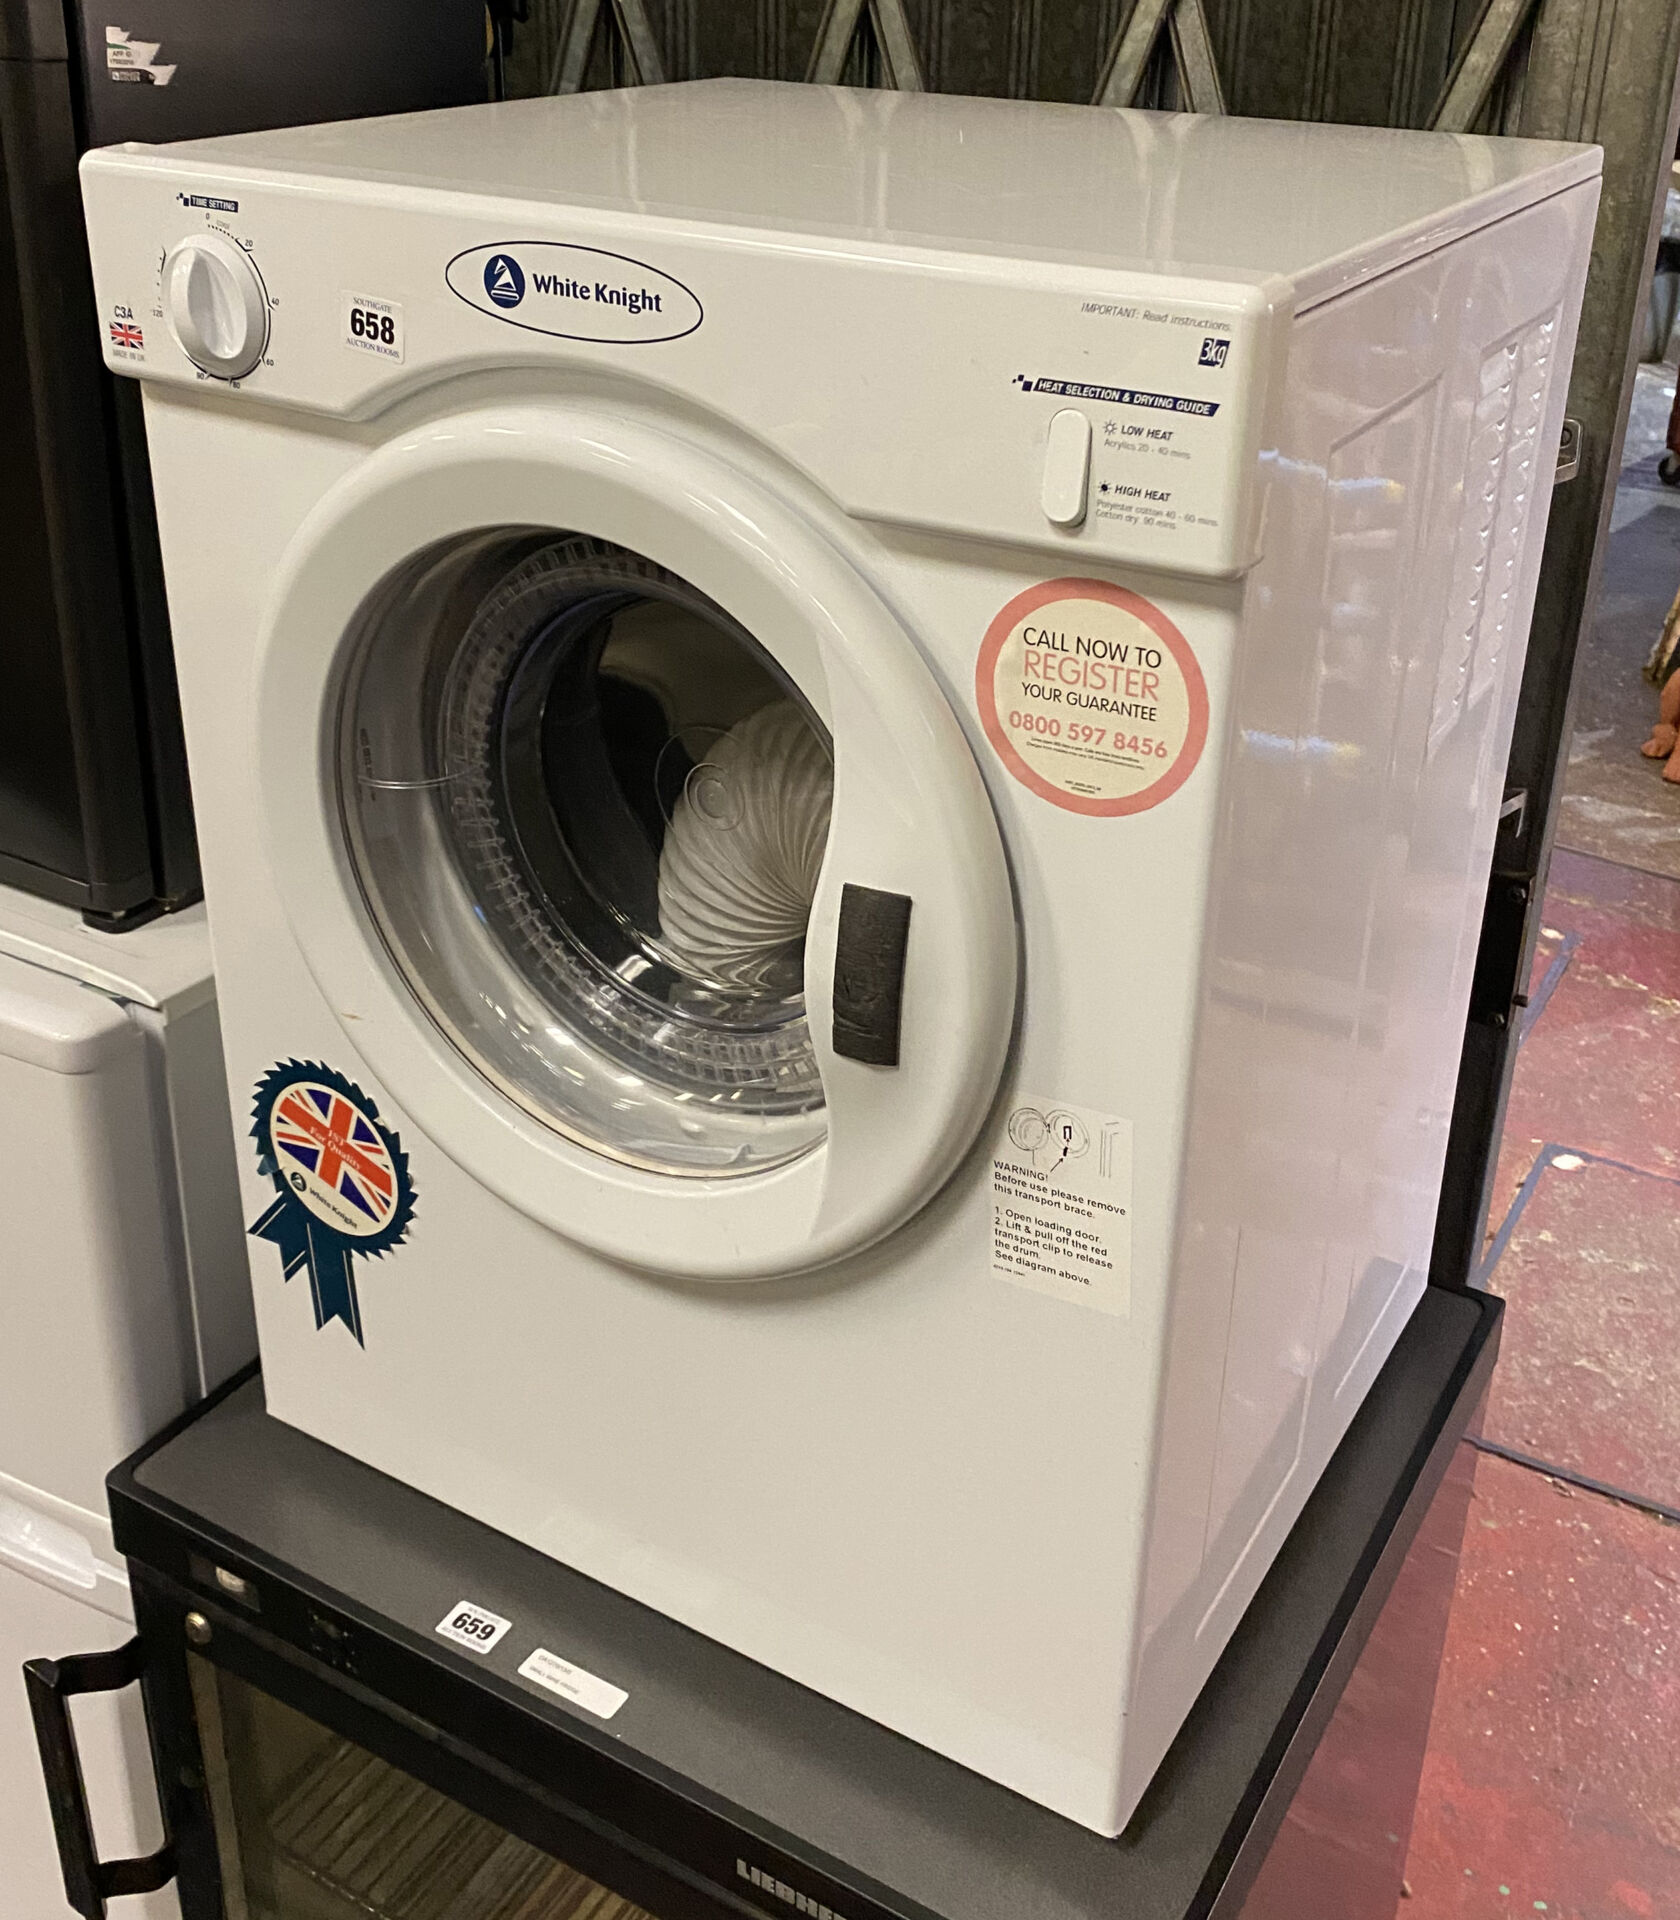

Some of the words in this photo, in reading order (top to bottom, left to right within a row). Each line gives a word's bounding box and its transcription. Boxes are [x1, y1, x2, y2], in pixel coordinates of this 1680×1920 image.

[191, 196, 207, 207] TIME
[208, 198, 236, 211] SETTING
[244, 238, 254, 247] 20
[271, 297, 280, 306] 40
[353, 296, 392, 313] SOUTHGATE
[532, 273, 591, 300] White
[595, 283, 662, 314] Knight
[114, 305, 134, 320] C3A
[350, 307, 395, 345] 658
[1081, 302, 1140, 320] IMPORTANT:
[1143, 310, 1168, 323] Read
[346, 337, 375, 351] AUCTION
[376, 345, 400, 359] ROOMS
[1200, 338, 1229, 368] 3kg
[1038, 380, 1064, 393] HEAT
[1065, 384, 1120, 401] SELECTION
[1122, 392, 1131, 402] &
[1134, 394, 1174, 409] DRYING
[1175, 401, 1212, 415] GUIDE
[1104, 438, 1136, 451] Acrylics
[1137, 443, 1149, 453] 20
[1121, 425, 1144, 436] LOW
[1146, 428, 1174, 441] HEAT
[1114, 484, 1142, 498] HIGH
[1144, 489, 1172, 502] HEAT
[1095, 509, 1123, 521] Cotton
[1023, 627, 1070, 653] CALL
[1076, 636, 1129, 663] NOW
[1135, 646, 1162, 669] TO
[1023, 649, 1160, 702] REGISTER
[1021, 682, 1062, 704] YOUR
[1066, 691, 1158, 722] GUARANTEE
[1008, 710, 1061, 737] 0800
[1067, 722, 1107, 746] 597
[1113, 731, 1168, 759] 8456
[310, 1126, 326, 1142] For
[327, 1140, 361, 1171] Quality
[993, 1159, 1049, 1181] WARNING!
[309, 1187, 332, 1209] White
[331, 1205, 358, 1230] Knight
[994, 1171, 1027, 1188] Before
[1030, 1183, 1048, 1194] use
[1051, 1188, 1084, 1204] please
[1087, 1199, 1127, 1216] remove
[994, 1183, 1013, 1195] this
[1014, 1188, 1061, 1209] transport
[1064, 1202, 1096, 1219] brace.
[995, 1206, 1003, 1215] 1.
[1005, 1208, 1032, 1223] Open
[1034, 1217, 1072, 1237] loading
[1075, 1229, 1102, 1244] door.
[1006, 1220, 1021, 1231] Lift
[1024, 1225, 1032, 1234] &
[1034, 1230, 1053, 1241] pull
[1055, 1235, 1069, 1245] off
[1071, 1239, 1088, 1251] the
[1091, 1246, 1107, 1257] red
[994, 1228, 1040, 1248] transport
[1042, 1242, 1061, 1255] clip
[1063, 1248, 1073, 1257] to
[1076, 1253, 1113, 1270] release
[994, 1238, 1011, 1250] the
[1012, 1244, 1041, 1260] drum.
[995, 1249, 1014, 1262] See
[1015, 1256, 1057, 1275] diagram
[1058, 1269, 1092, 1286] above.
[452, 1612, 496, 1641] 659
